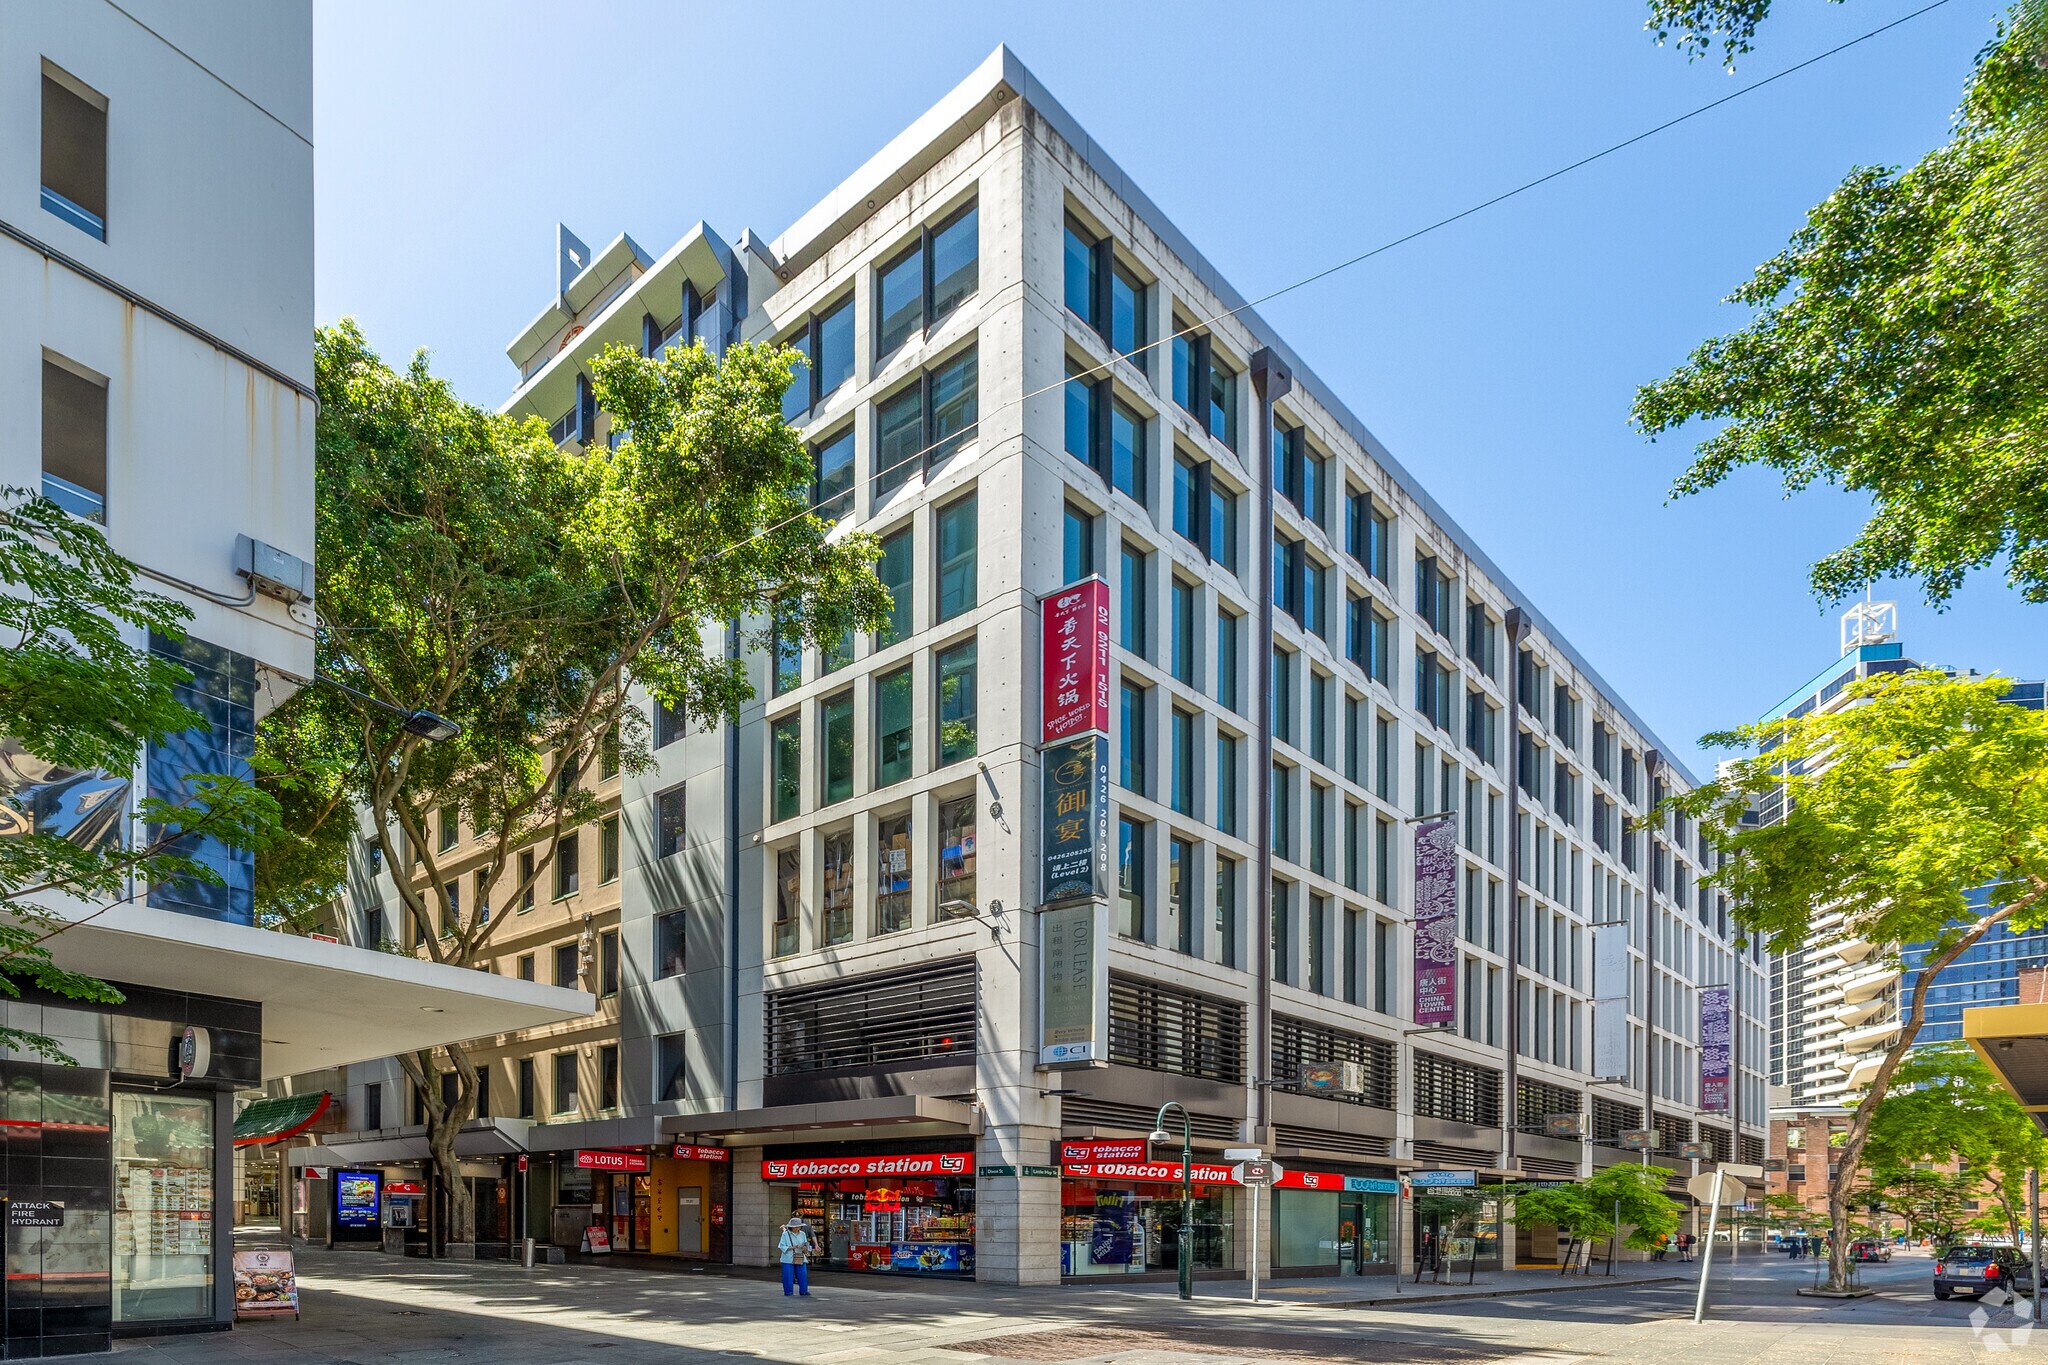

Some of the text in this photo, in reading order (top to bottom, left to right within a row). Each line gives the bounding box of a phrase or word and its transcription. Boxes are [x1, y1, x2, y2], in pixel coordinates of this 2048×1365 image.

[1058, 617, 1081, 706] 香天下火锅
[1047, 703, 1090, 730] SPICE WORLD
[1056, 789, 1086, 844] 御宴
[1051, 868, 1079, 879] (Level
[1073, 920, 1088, 991] FOR LEASE
[1420, 977, 1446, 986] 唐人街
[1419, 1005, 1452, 1014] CENTRE
[595, 1156, 622, 1165] LOTUS
[1064, 1146, 1090, 1159] tsg
[768, 1155, 964, 1177] tsg tobacco station tsg
[1097, 1164, 1168, 1178] tobacco
[1173, 1166, 1227, 1181] sation
[1304, 1173, 1318, 1188] tsg
[1094, 1237, 1113, 1254] DAIRY
[1097, 1244, 1113, 1259] MILK
